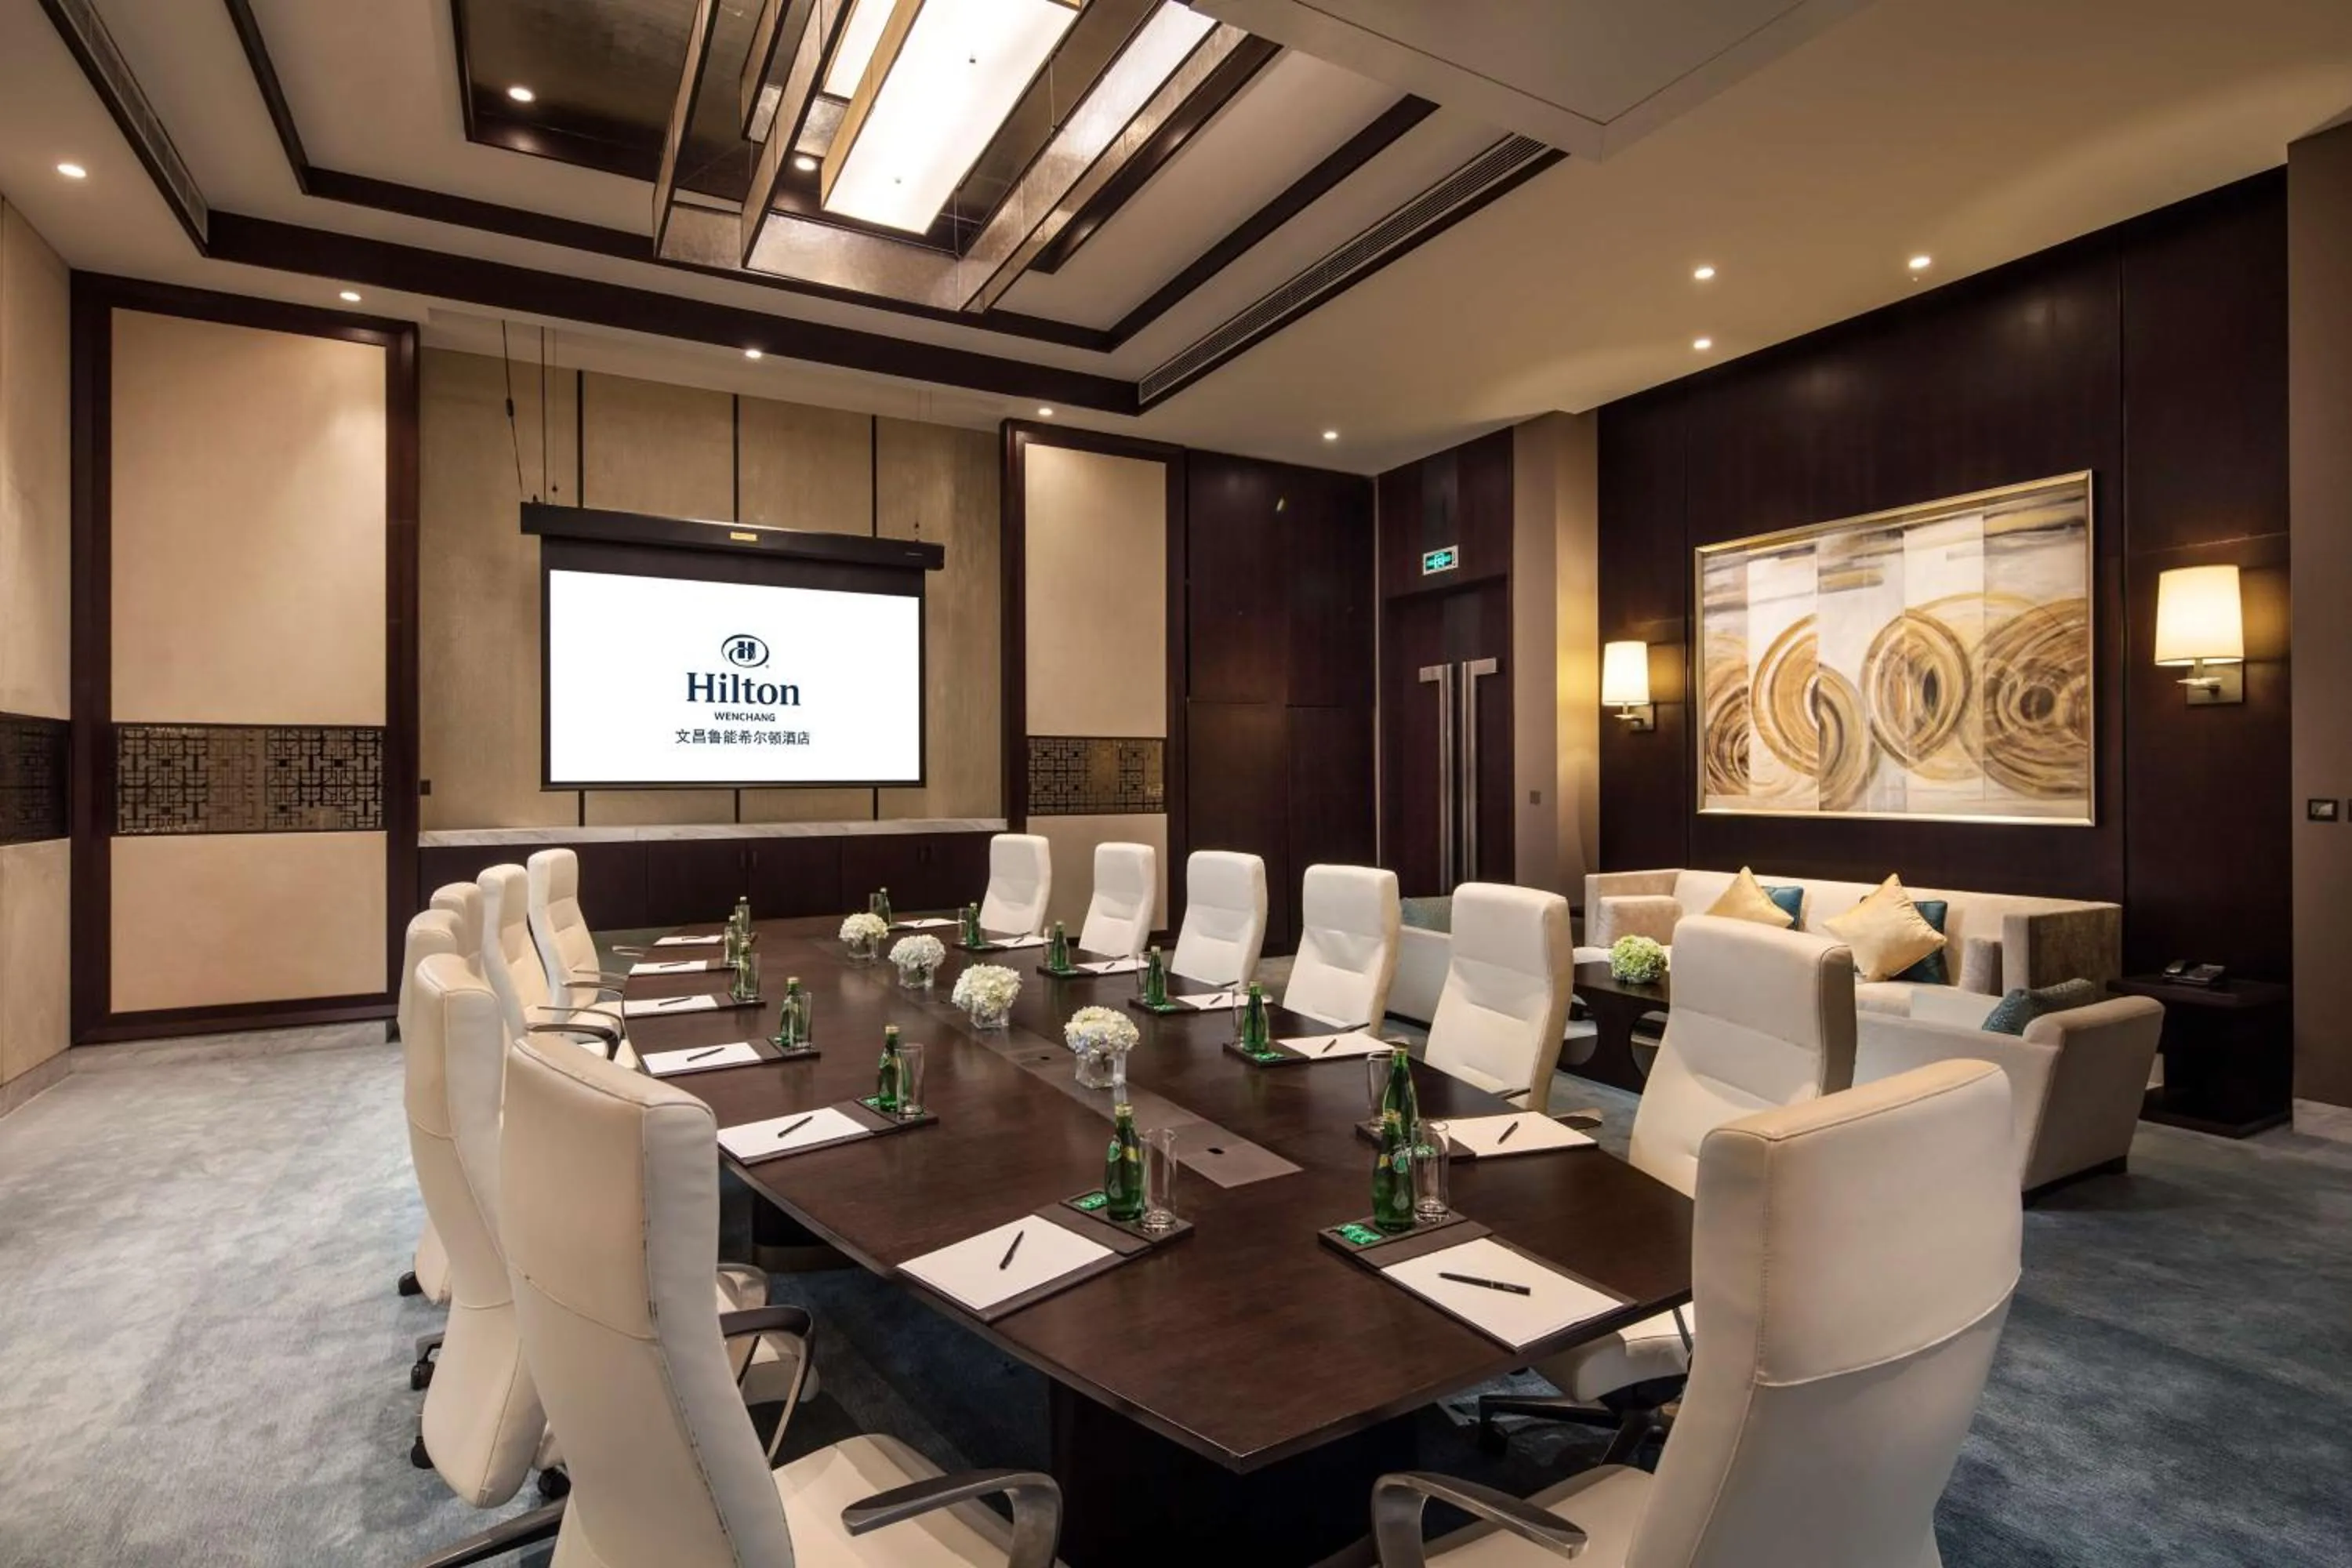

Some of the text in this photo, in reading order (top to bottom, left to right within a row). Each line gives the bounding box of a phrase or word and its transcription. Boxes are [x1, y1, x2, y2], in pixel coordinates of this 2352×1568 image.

[686, 672, 801, 706] Hilton
[714, 711, 776, 722] WENCHANG
[675, 728, 810, 746] 文昌鲁能希尔顿酒店
